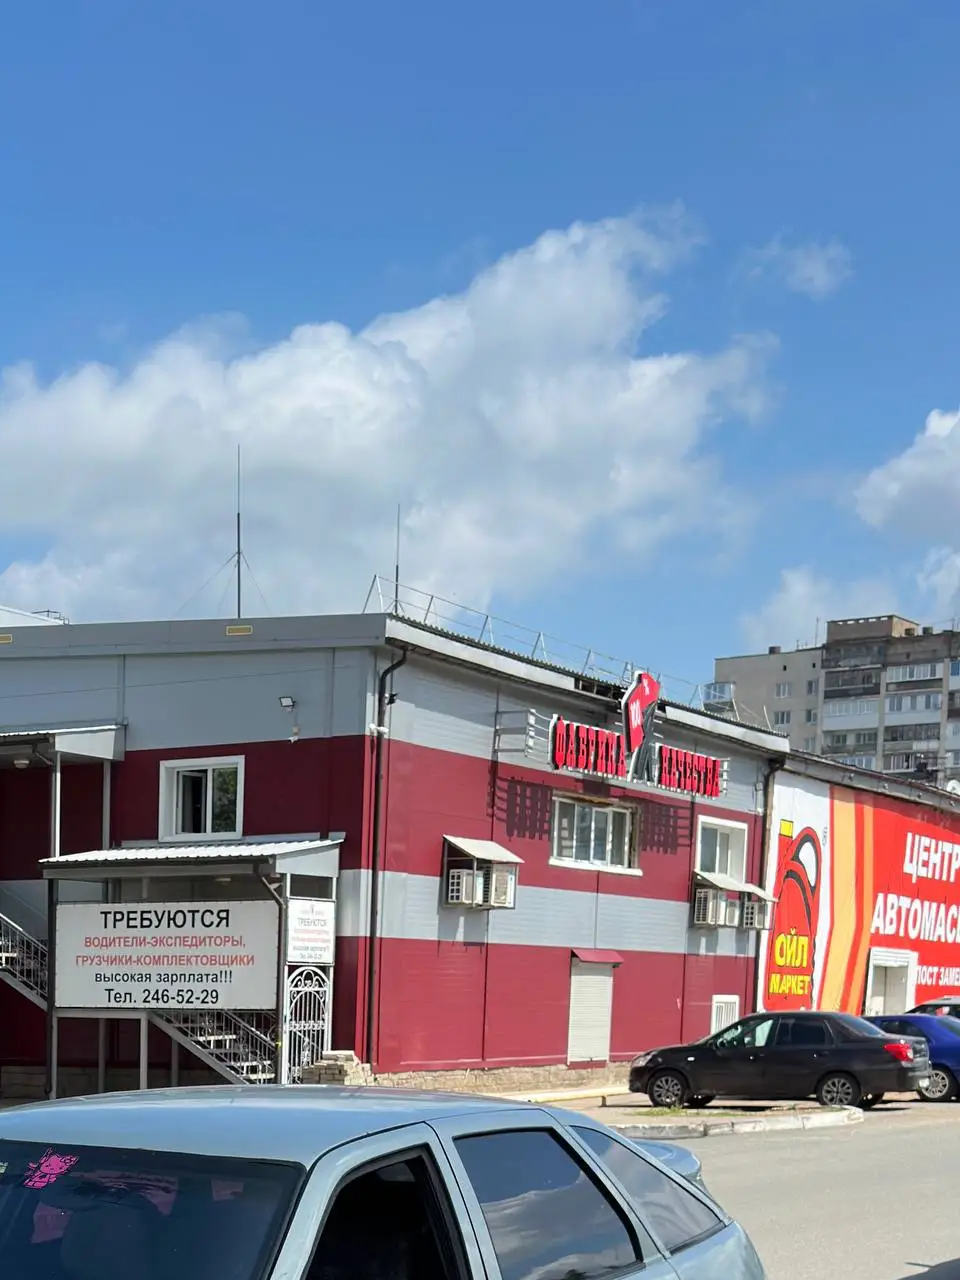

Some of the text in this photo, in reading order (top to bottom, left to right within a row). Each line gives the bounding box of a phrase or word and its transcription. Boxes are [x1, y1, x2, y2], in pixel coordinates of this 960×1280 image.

[556, 716, 720, 798] ФАБРИКА КАЧЕСТВА
[903, 831, 960, 884] ЦЕНТР
[100, 909, 229, 929] ТРЕБУЮТСЯ
[84, 935, 246, 949] ВОДИТЕЛИ-ЭКСПЕДИТОРЫ,
[774, 927, 808, 968] ОЙЛ
[75, 954, 255, 967] ГРУЗЧИКИ-КОМПЛЕКТОВЩИКИ
[95, 970, 233, 986] высокая зарплата!!!
[769, 973, 810, 995] МАРКЕТ
[104, 988, 219, 1004] Тел. 246-52-29
